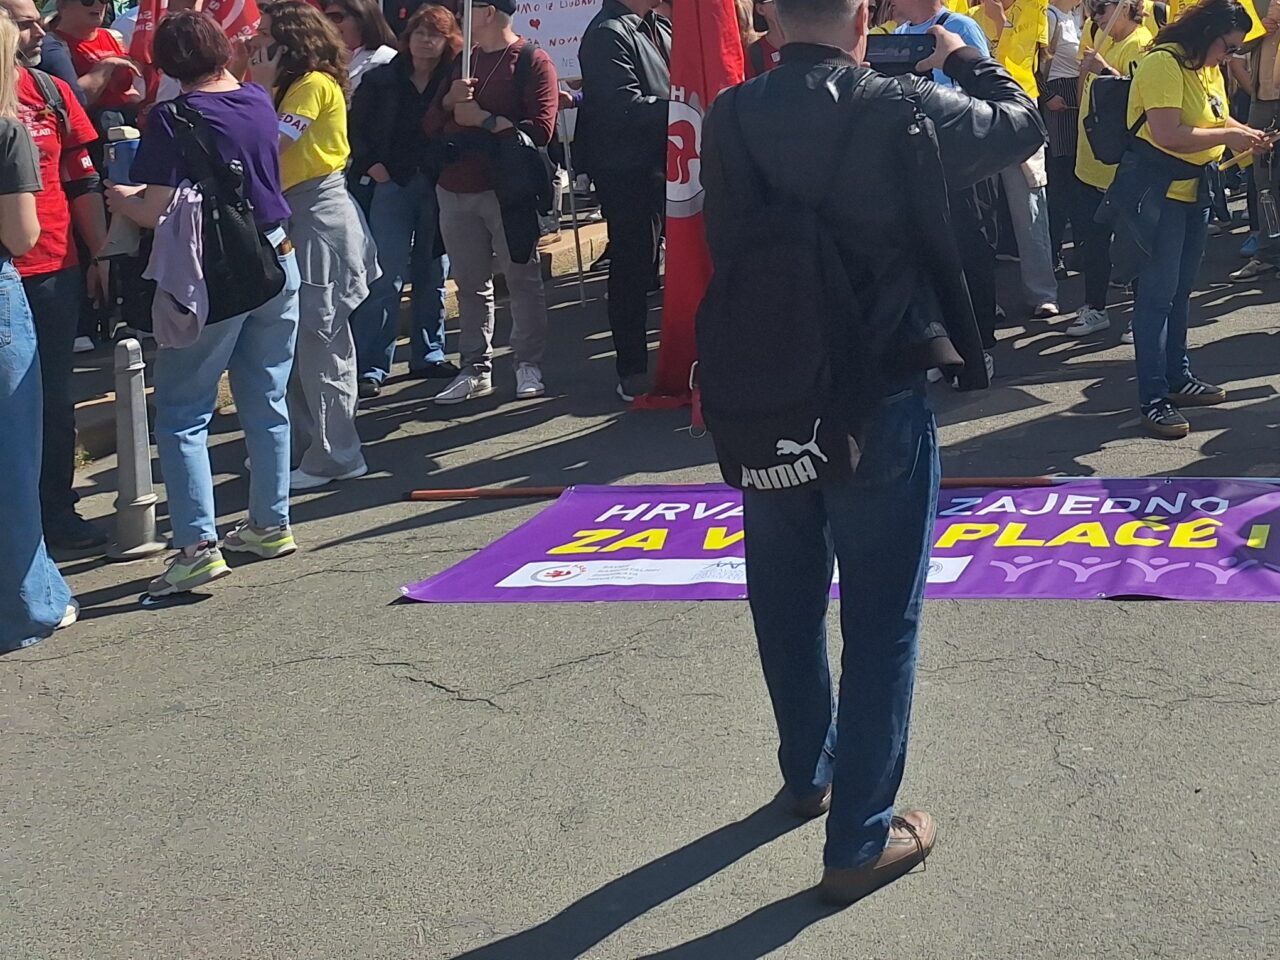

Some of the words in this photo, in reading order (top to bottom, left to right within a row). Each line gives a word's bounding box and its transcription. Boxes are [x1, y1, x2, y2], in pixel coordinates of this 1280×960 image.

[549, 36, 578, 47] NOVA
[938, 492, 1230, 516] ZAJEDNO
[545, 528, 669, 554] ZA
[933, 516, 1223, 549] PLAĆE
[1246, 523, 1270, 549] I
